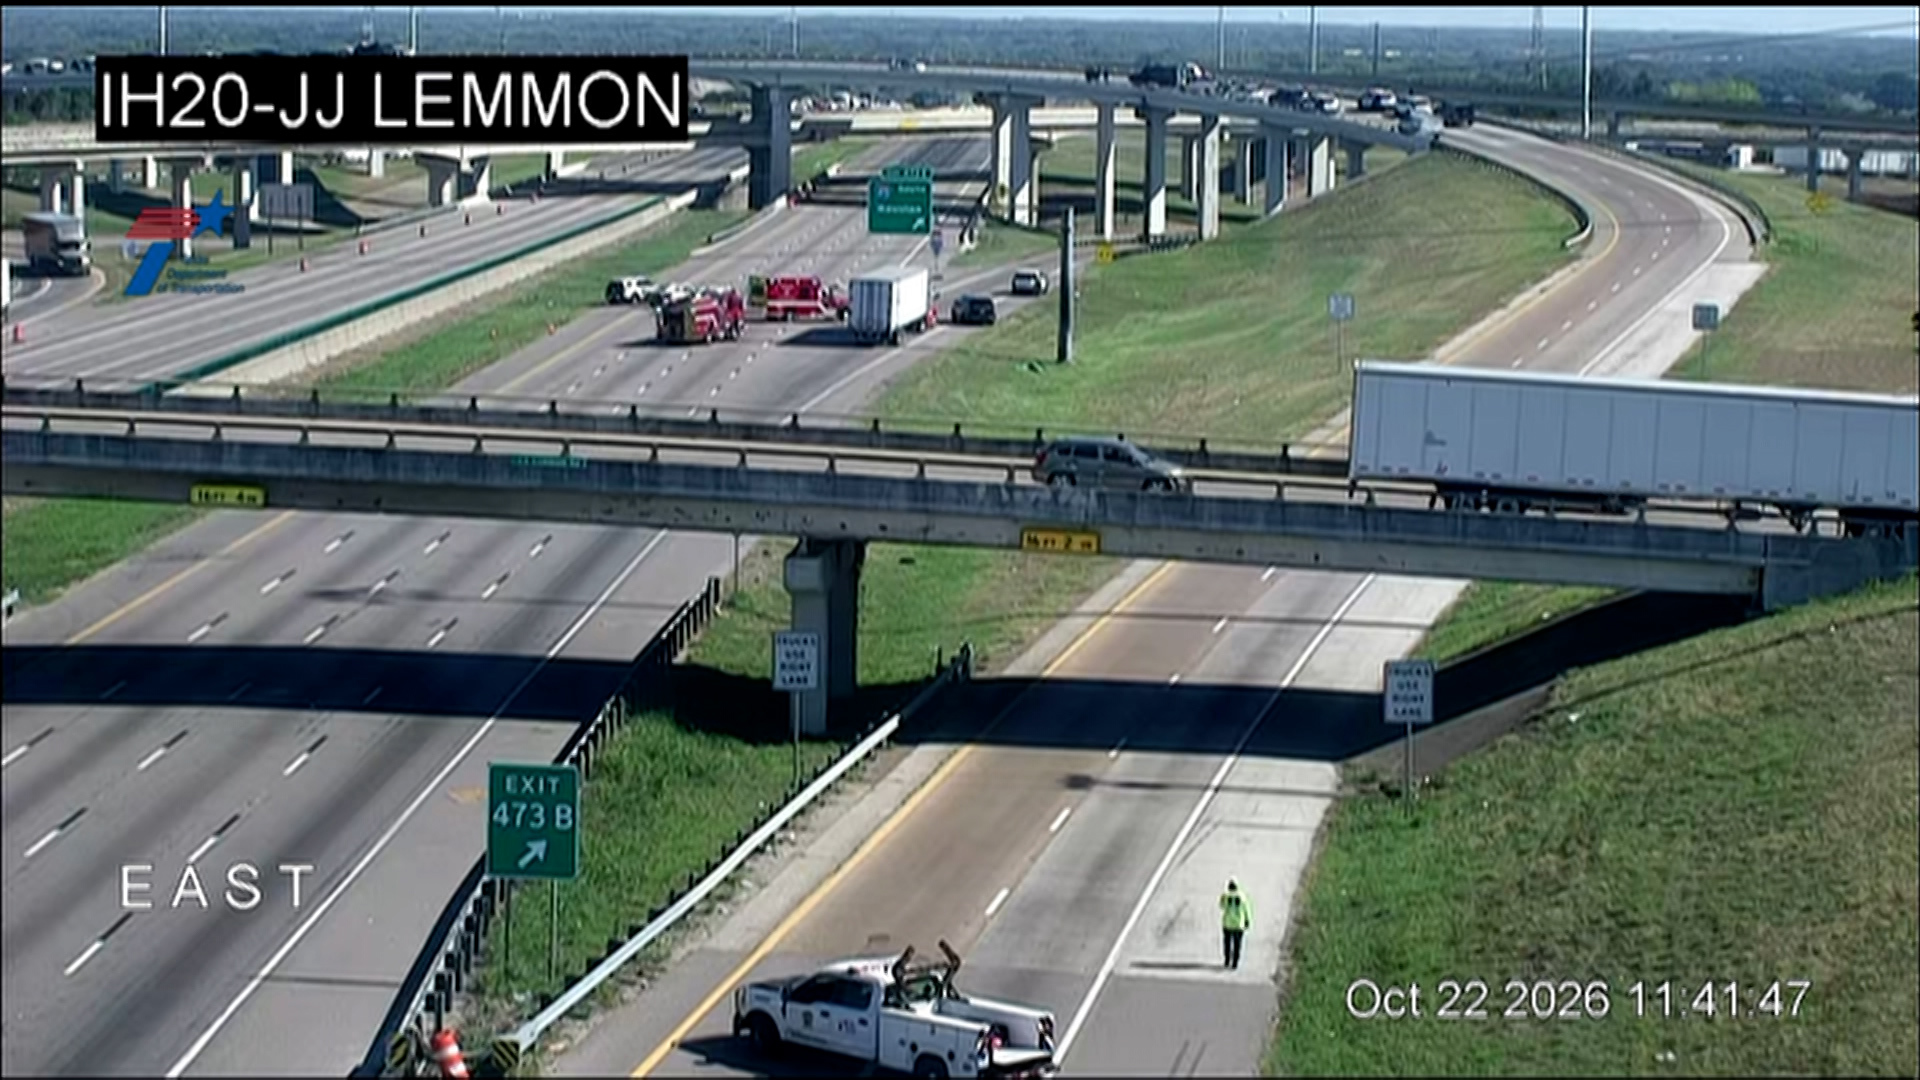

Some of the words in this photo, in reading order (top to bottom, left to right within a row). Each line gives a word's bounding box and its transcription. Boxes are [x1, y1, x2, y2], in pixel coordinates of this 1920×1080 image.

[776, 636, 817, 647] TRUCKS
[785, 649, 806, 660] USE
[780, 661, 812, 672] RIGHT
[1387, 667, 1430, 678] TRUCKS
[781, 675, 809, 686] LANE
[1397, 680, 1419, 691] USE
[1392, 693, 1425, 704] RIGHT
[1393, 707, 1422, 718] LANE
[505, 774, 561, 796] EXIT
[492, 800, 547, 830] 473
[554, 802, 573, 831] B
